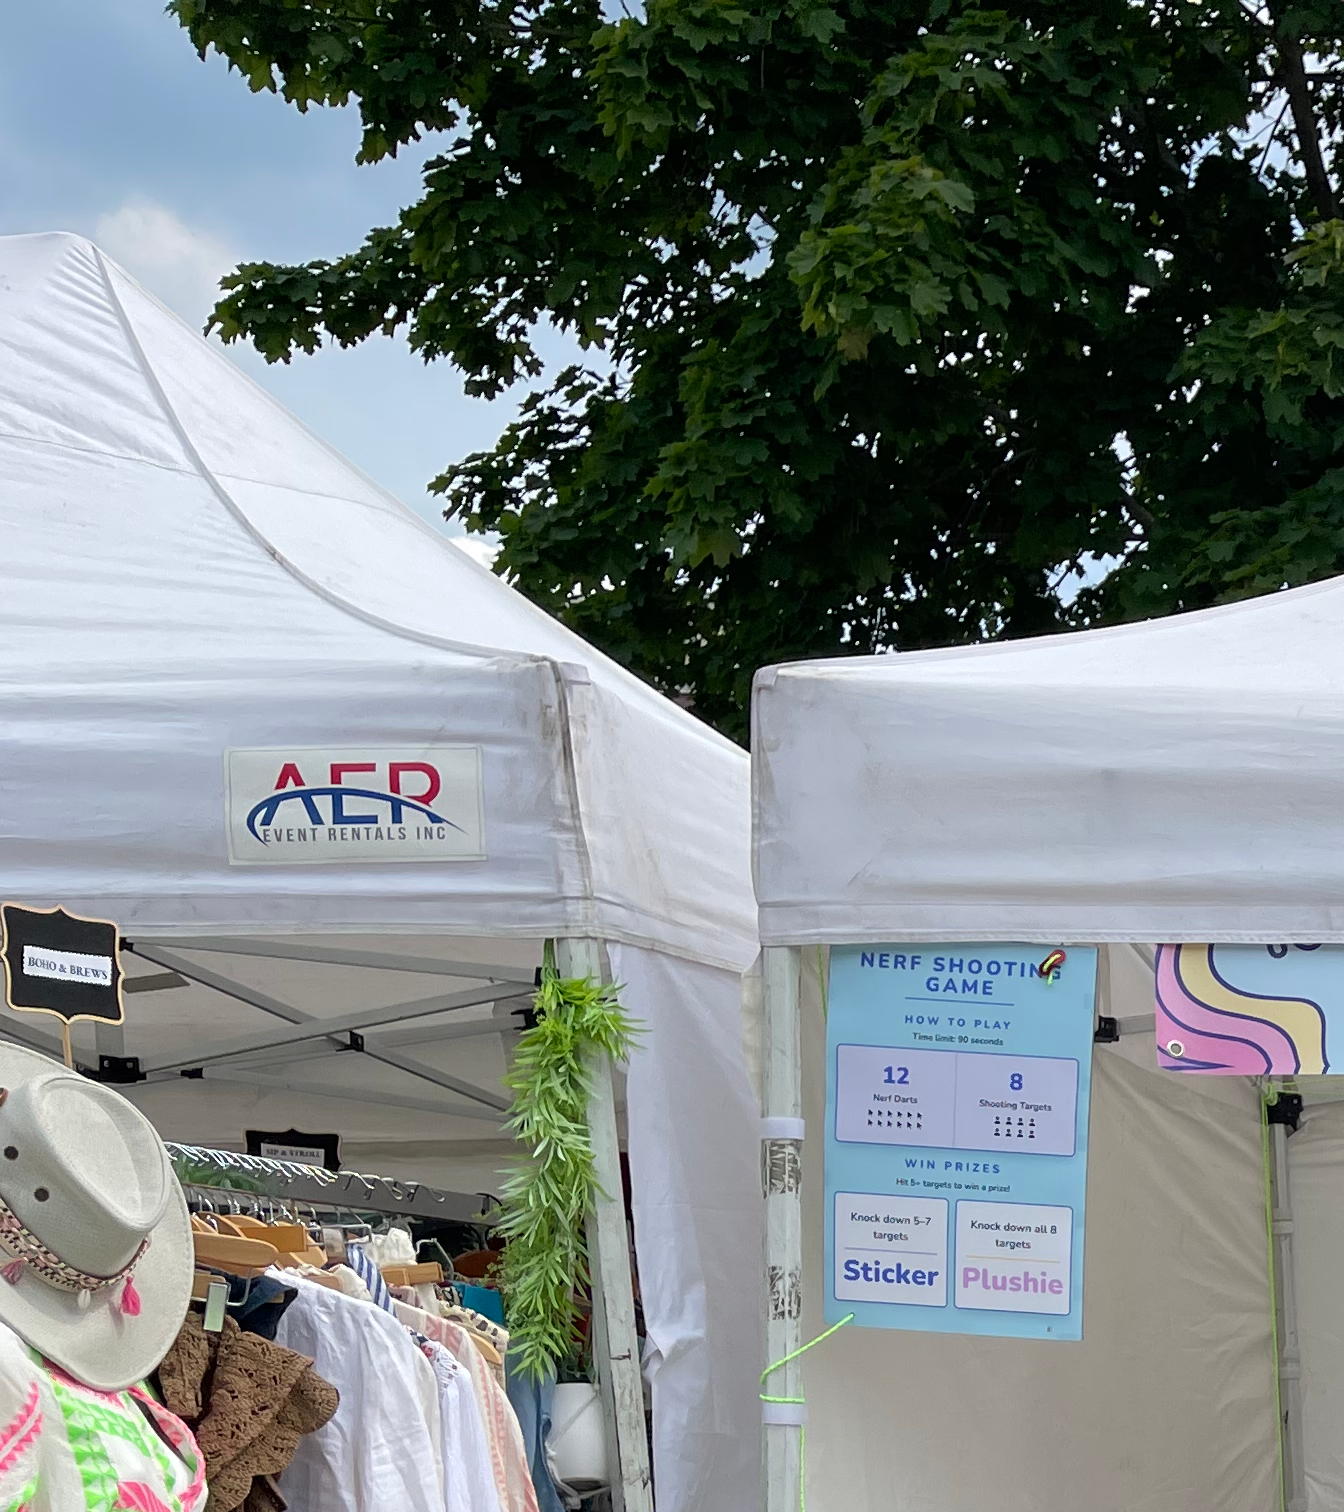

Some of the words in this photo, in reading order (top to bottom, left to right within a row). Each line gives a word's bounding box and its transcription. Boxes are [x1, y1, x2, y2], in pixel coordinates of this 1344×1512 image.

[260, 762, 445, 826] AER
[263, 827, 318, 842] EVENT
[328, 826, 407, 841] RENTALS
[416, 826, 446, 840] INC
[28, 957, 57, 971] BOHO
[58, 963, 67, 974] &
[70, 965, 108, 980] BREWS
[860, 951, 922, 971] NERF
[926, 976, 994, 996] GAME
[904, 1014, 940, 1026] HOW
[947, 1017, 966, 1028] TO
[974, 1019, 1011, 1030] PLAY
[912, 1032, 933, 1042] Time
[935, 1033, 955, 1043] limit:
[958, 1035, 969, 1044] 90
[970, 1036, 1004, 1046] seconds
[883, 1065, 910, 1085] 12
[1009, 1072, 1023, 1091] 8
[873, 1093, 892, 1103] Nerf
[894, 1094, 918, 1104] Darts
[979, 1099, 1018, 1111] Shooting
[1020, 1101, 1052, 1112] Targets
[904, 1158, 936, 1170] WIN
[944, 1161, 1001, 1174] PRIZES
[896, 1178, 909, 1186] Hit
[922, 1180, 952, 1190] targets
[954, 1181, 963, 1189] to
[964, 1182, 980, 1191] win
[850, 1212, 881, 1223] Knock
[883, 1214, 911, 1225] down
[970, 1219, 1001, 1231] Knock
[1003, 1222, 1032, 1233] down
[1034, 1224, 1048, 1234] all
[1050, 1225, 1057, 1235] 8
[873, 1230, 909, 1241] targets
[995, 1238, 1032, 1250] targets
[843, 1259, 939, 1287] Sticker
[962, 1267, 1064, 1295] Plushie
